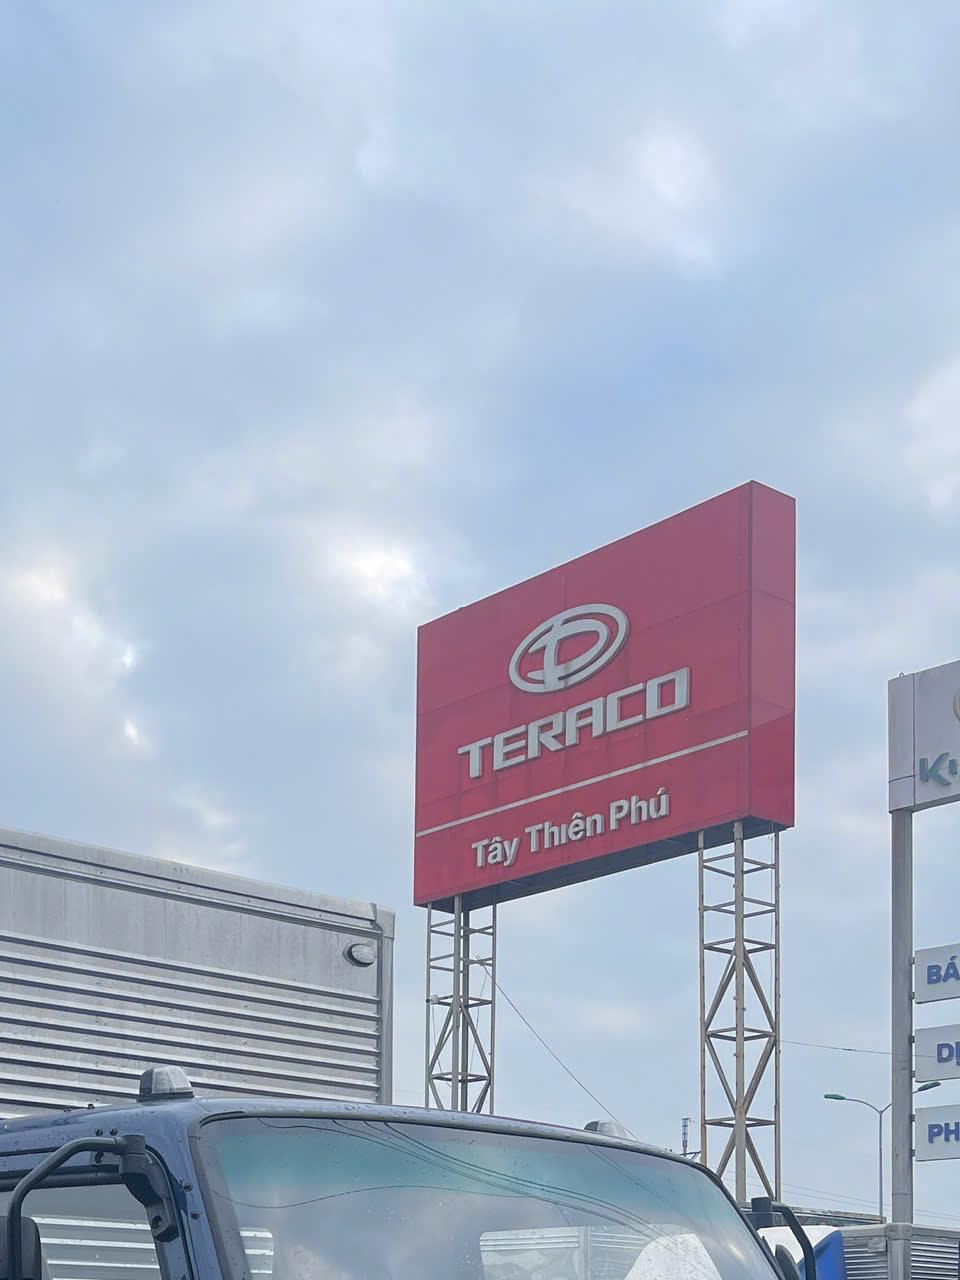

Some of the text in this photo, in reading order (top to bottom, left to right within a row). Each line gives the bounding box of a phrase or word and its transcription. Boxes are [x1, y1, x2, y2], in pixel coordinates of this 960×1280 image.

[457, 667, 691, 779] TERACO
[471, 787, 670, 867] Tây Thiên Phú
[927, 955, 960, 984] BÁ
[928, 1121, 960, 1143] PH
